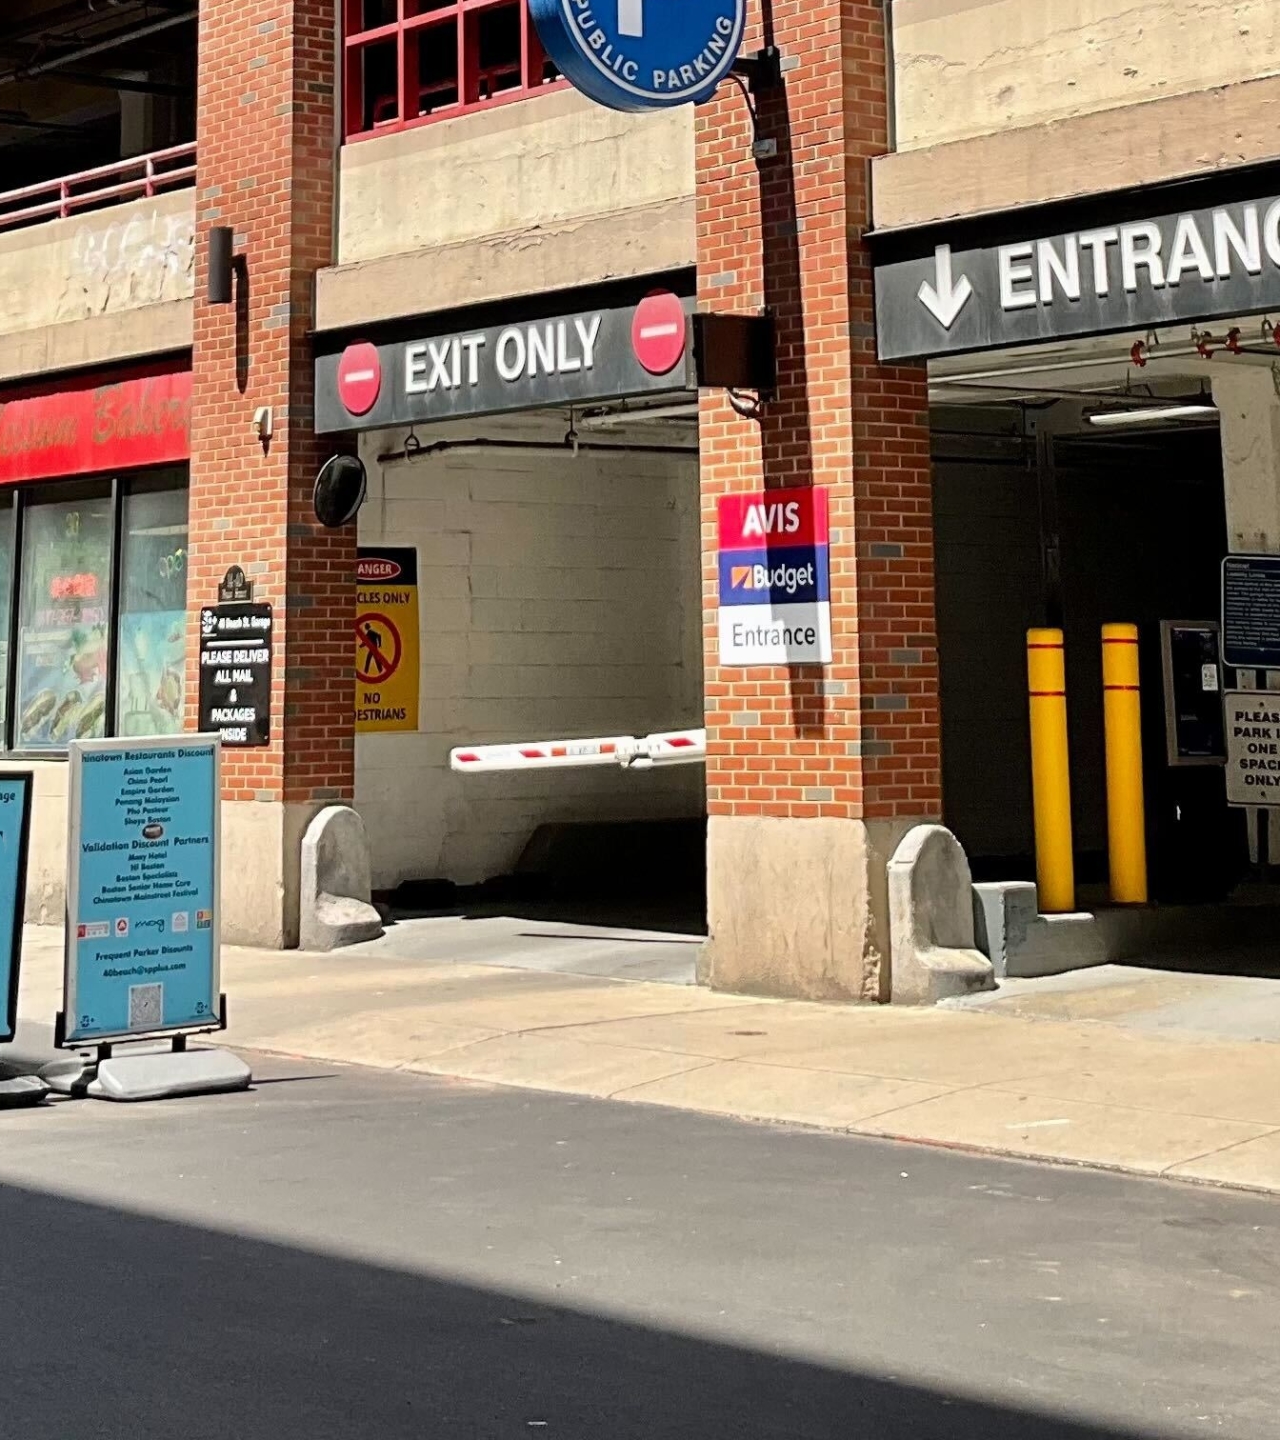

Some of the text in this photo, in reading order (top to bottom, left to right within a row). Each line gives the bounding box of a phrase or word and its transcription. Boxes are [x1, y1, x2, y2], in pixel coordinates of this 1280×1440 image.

[652, 15, 734, 90] PARKING
[404, 314, 602, 394] EXIT ONLY
[741, 501, 800, 538] AVIS
[357, 563, 393, 575] ANGER
[753, 562, 814, 594] Budget
[357, 592, 411, 604] CLES ONLY
[732, 622, 816, 648] Entrance
[201, 648, 270, 664] PLEASE DELIVER
[215, 668, 254, 683] ALL MAIL
[363, 692, 381, 704] NO
[211, 707, 256, 722] PACKAGES
[1233, 727, 1271, 739] PARK
[125, 750, 175, 760] Restaurants
[1247, 743, 1278, 755] ONE
[145, 766, 172, 775] Garden
[149, 776, 168, 784] Pearl
[121, 786, 175, 797] Empire Garden
[147, 815, 172, 823] Boston
[82, 836, 209, 853] Validation Discount Partners
[148, 851, 168, 859] Hotel
[141, 862, 165, 870] Boston
[116, 874, 141, 882] Boston
[102, 885, 127, 893] Boston
[128, 883, 151, 892] Senior
[152, 881, 173, 889] Home
[93, 888, 198, 904] Chinatown Mainstreet Festival
[95, 948, 159, 961] Frequent Parker
